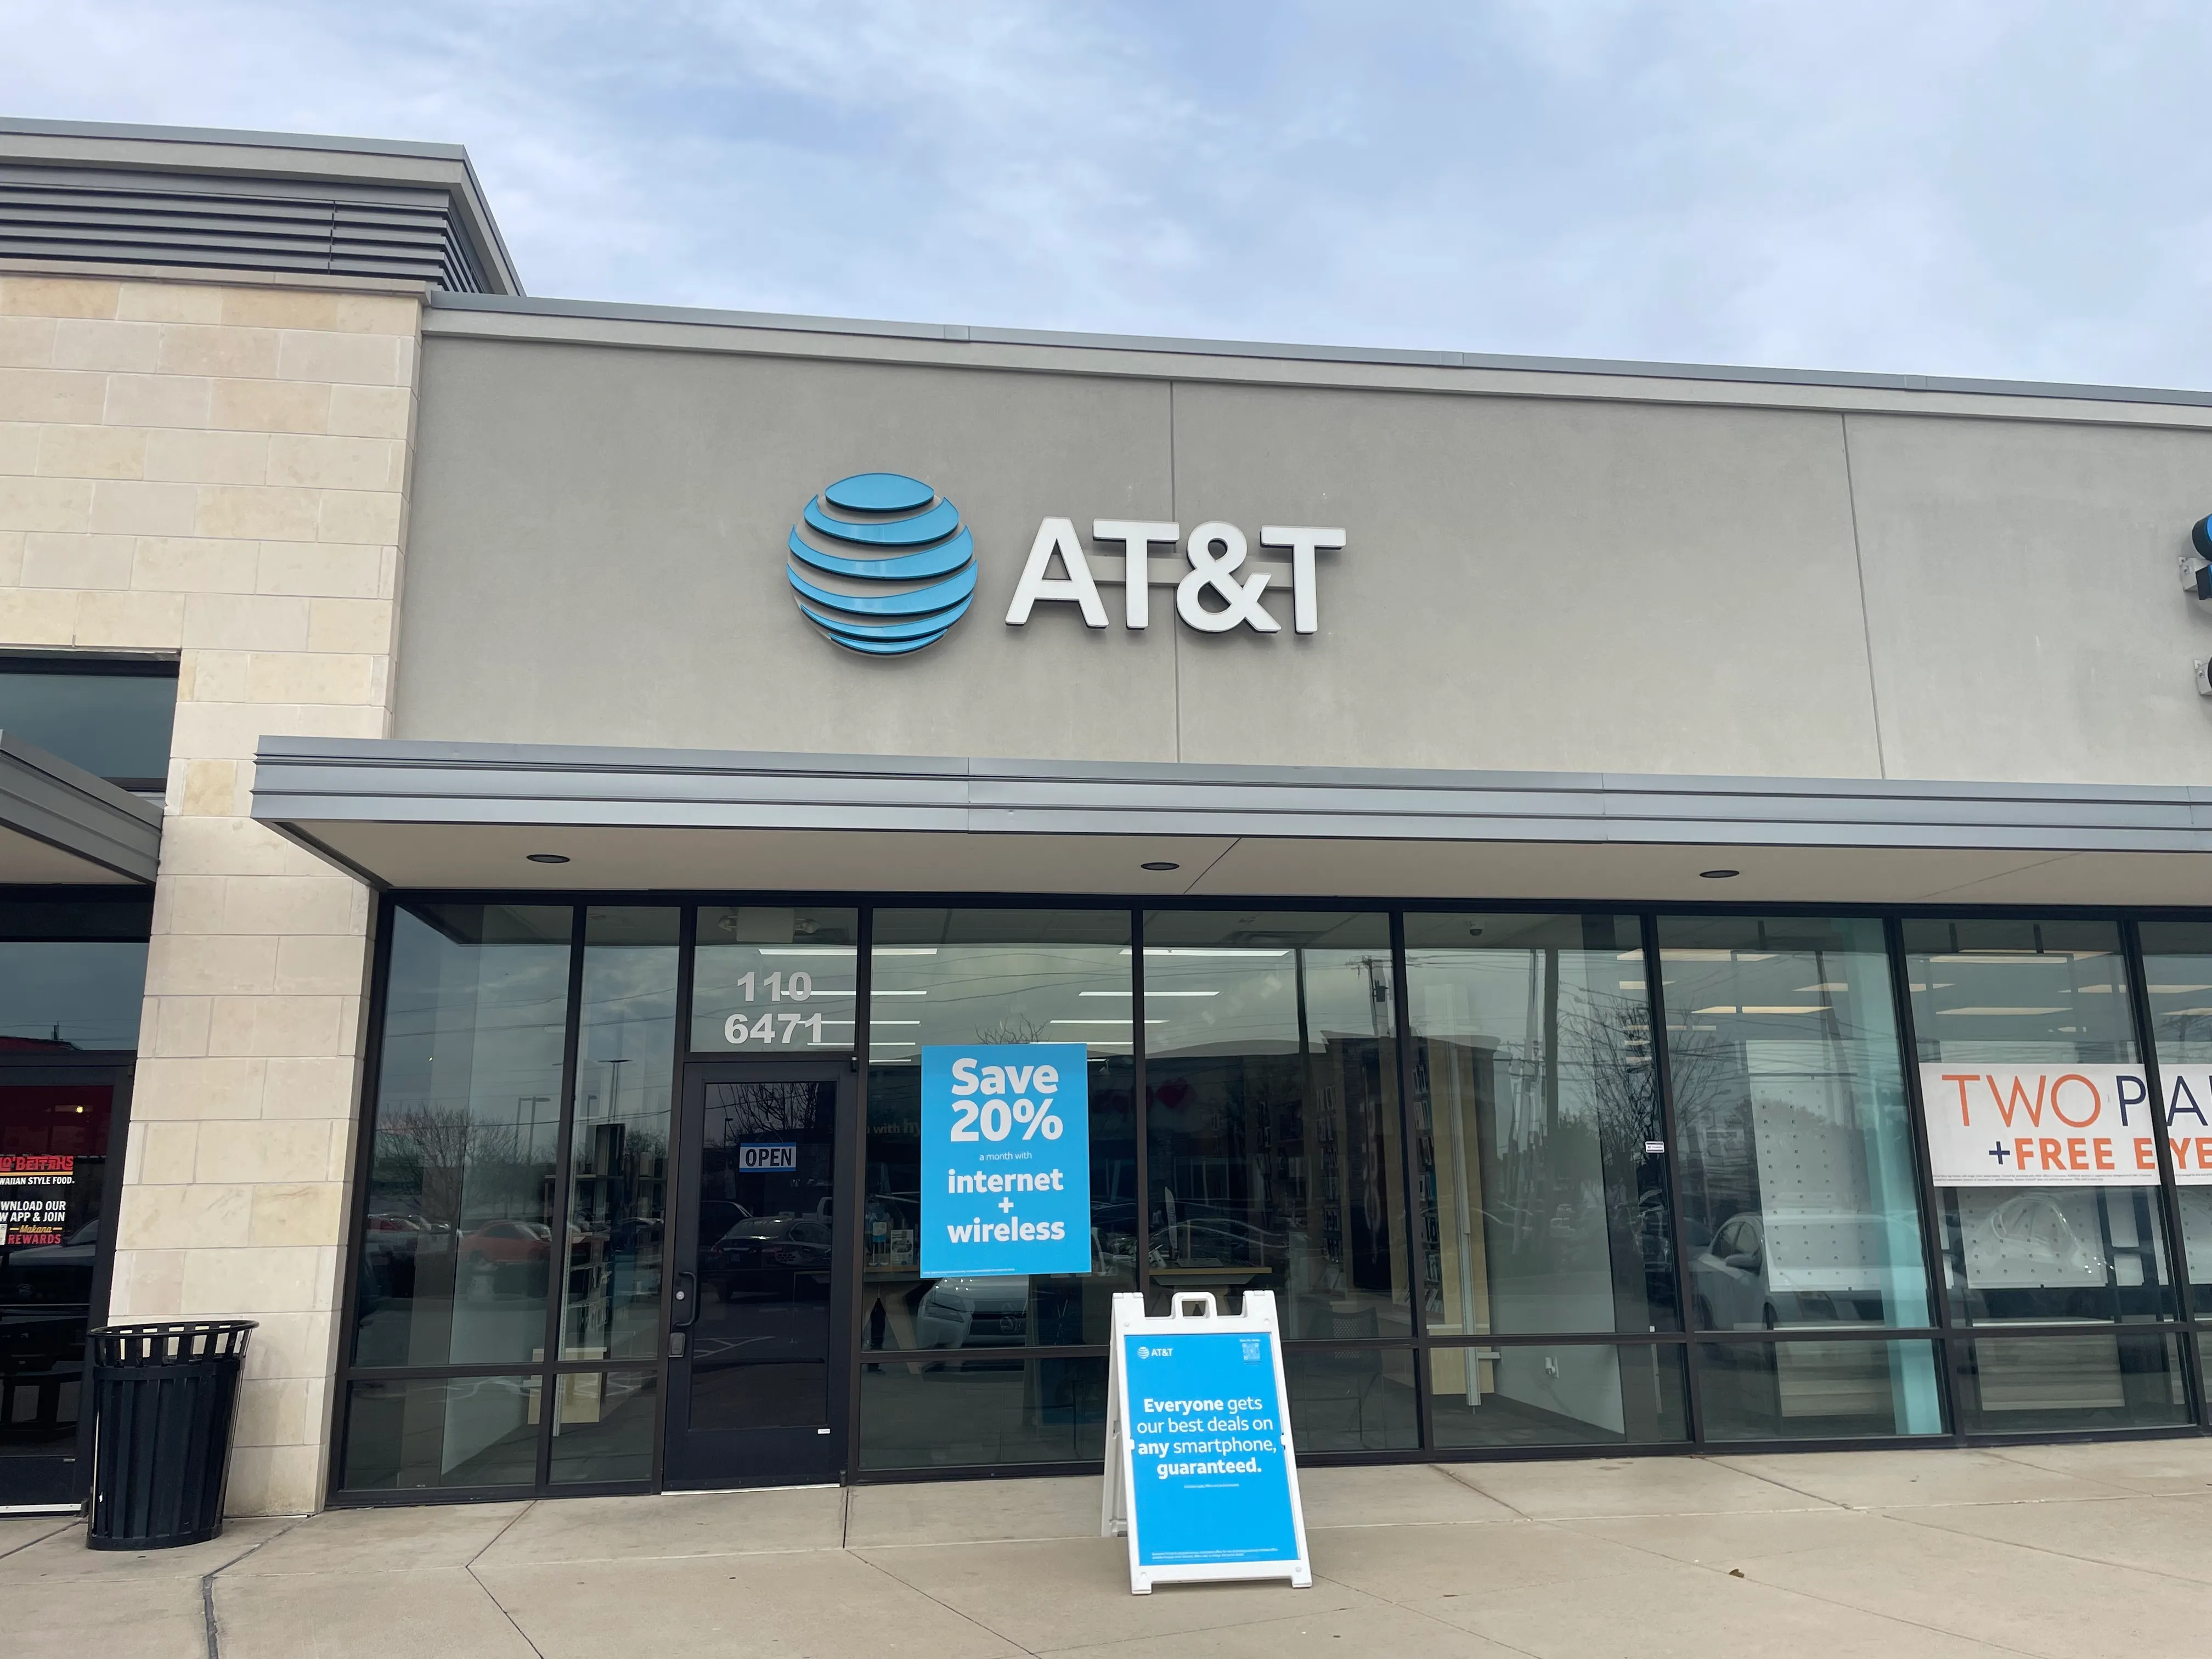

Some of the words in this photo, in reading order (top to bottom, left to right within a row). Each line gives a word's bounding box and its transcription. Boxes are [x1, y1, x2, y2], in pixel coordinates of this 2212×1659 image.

[1005, 516, 1346, 634] AT&T
[737, 972, 812, 1002] 110
[724, 1013, 822, 1044] 6471
[951, 1058, 1059, 1096] Save
[1942, 1074, 2101, 1128] TWO
[2115, 1075, 2212, 1127] PA
[950, 1098, 1063, 1142] 20%
[745, 1148, 792, 1167] OPEN
[986, 1152, 1013, 1160] month
[1015, 1151, 1032, 1159] with
[28, 1177, 50, 1185] STYLE
[948, 1169, 1064, 1194] internet
[46, 1200, 66, 1211] OUR
[10, 1212, 31, 1222] APP
[32, 1212, 41, 1222] &
[43, 1211, 65, 1222] JOIN
[19, 1224, 53, 1233] Makana
[947, 1216, 1065, 1243] wireless
[8, 1234, 61, 1244] REWARDS
[1151, 1348, 1173, 1357] AT&T
[1144, 1398, 1224, 1415] Everyone
[1227, 1396, 1263, 1414] gets
[1137, 1421, 1164, 1434] our
[1168, 1418, 1204, 1433] best
[1207, 1416, 1249, 1431] deals
[1252, 1419, 1273, 1430] on
[1138, 1442, 1170, 1458] any
[1173, 1436, 1277, 1456] smartphone,
[1157, 1457, 1262, 1480] guaranteed.
